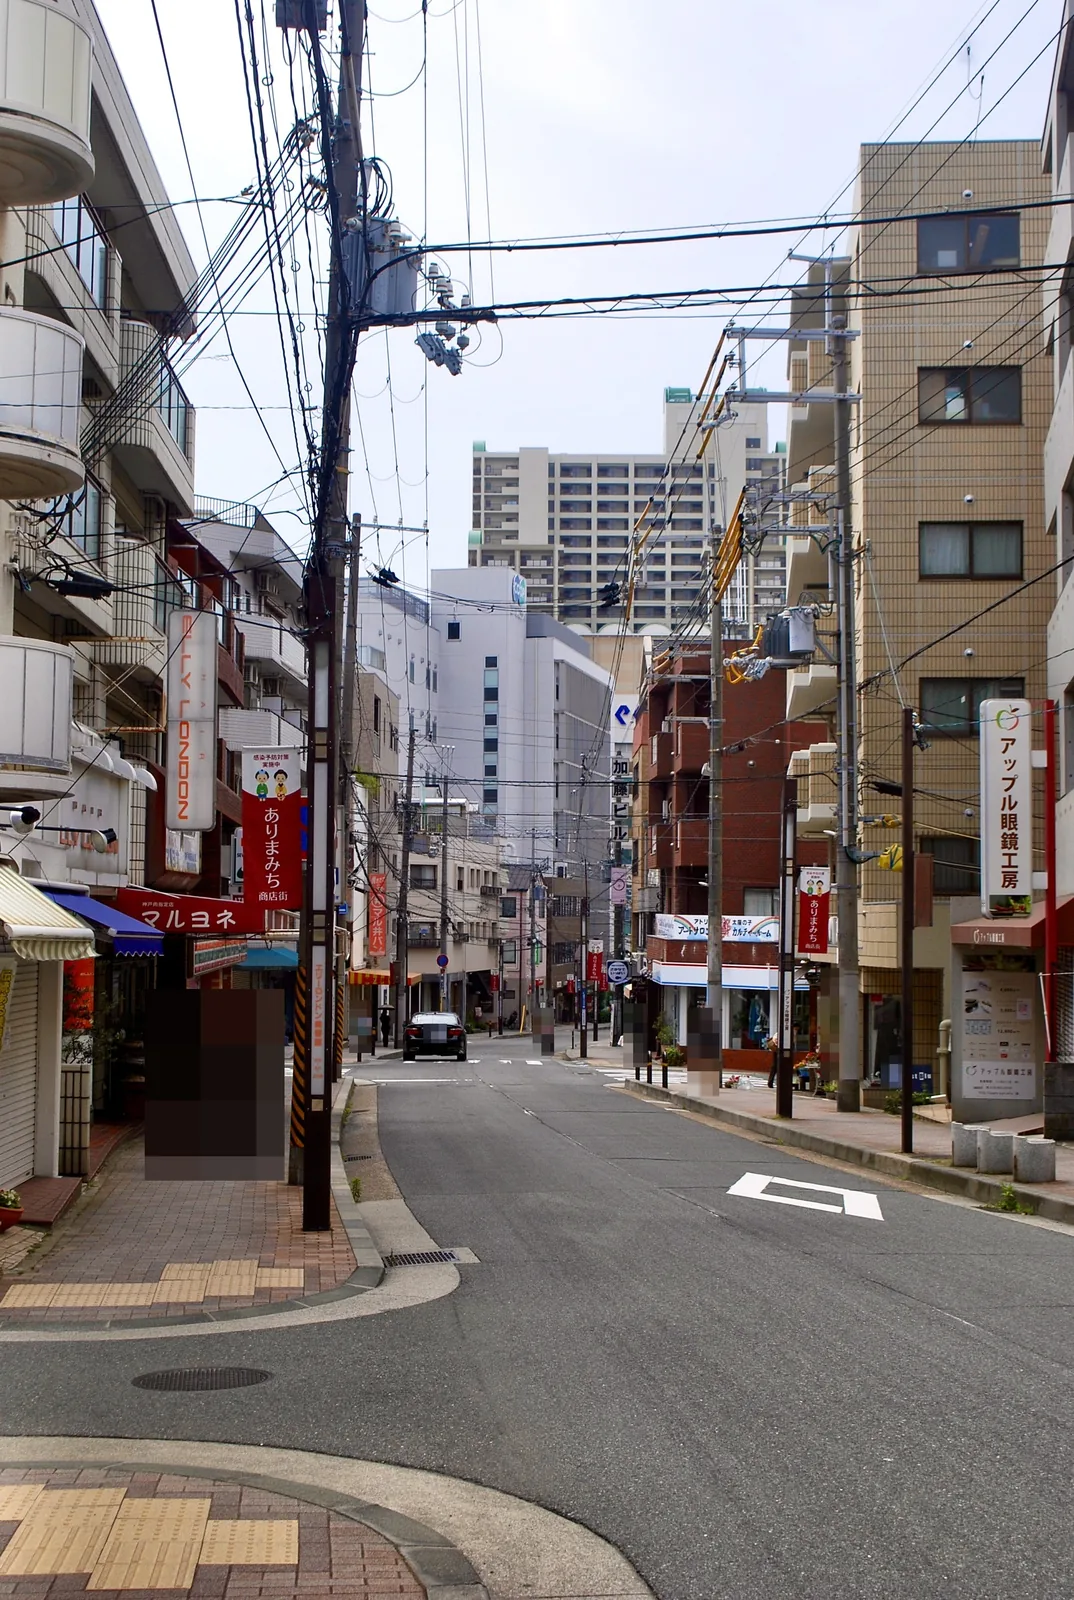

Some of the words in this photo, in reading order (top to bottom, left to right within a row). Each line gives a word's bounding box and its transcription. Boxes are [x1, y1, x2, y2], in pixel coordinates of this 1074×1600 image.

[180, 614, 192, 689] ELLY
[177, 699, 190, 820] LONDON
[264, 807, 281, 889] ありまみち
[1000, 737, 1019, 889] アップル眼鏡工房
[141, 909, 236, 929] マルヨネ
[258, 891, 288, 902] 商店街
[372, 908, 384, 952] マル井パン
[808, 899, 819, 943] ありまみち
[314, 964, 323, 1047] エリーロンドン
